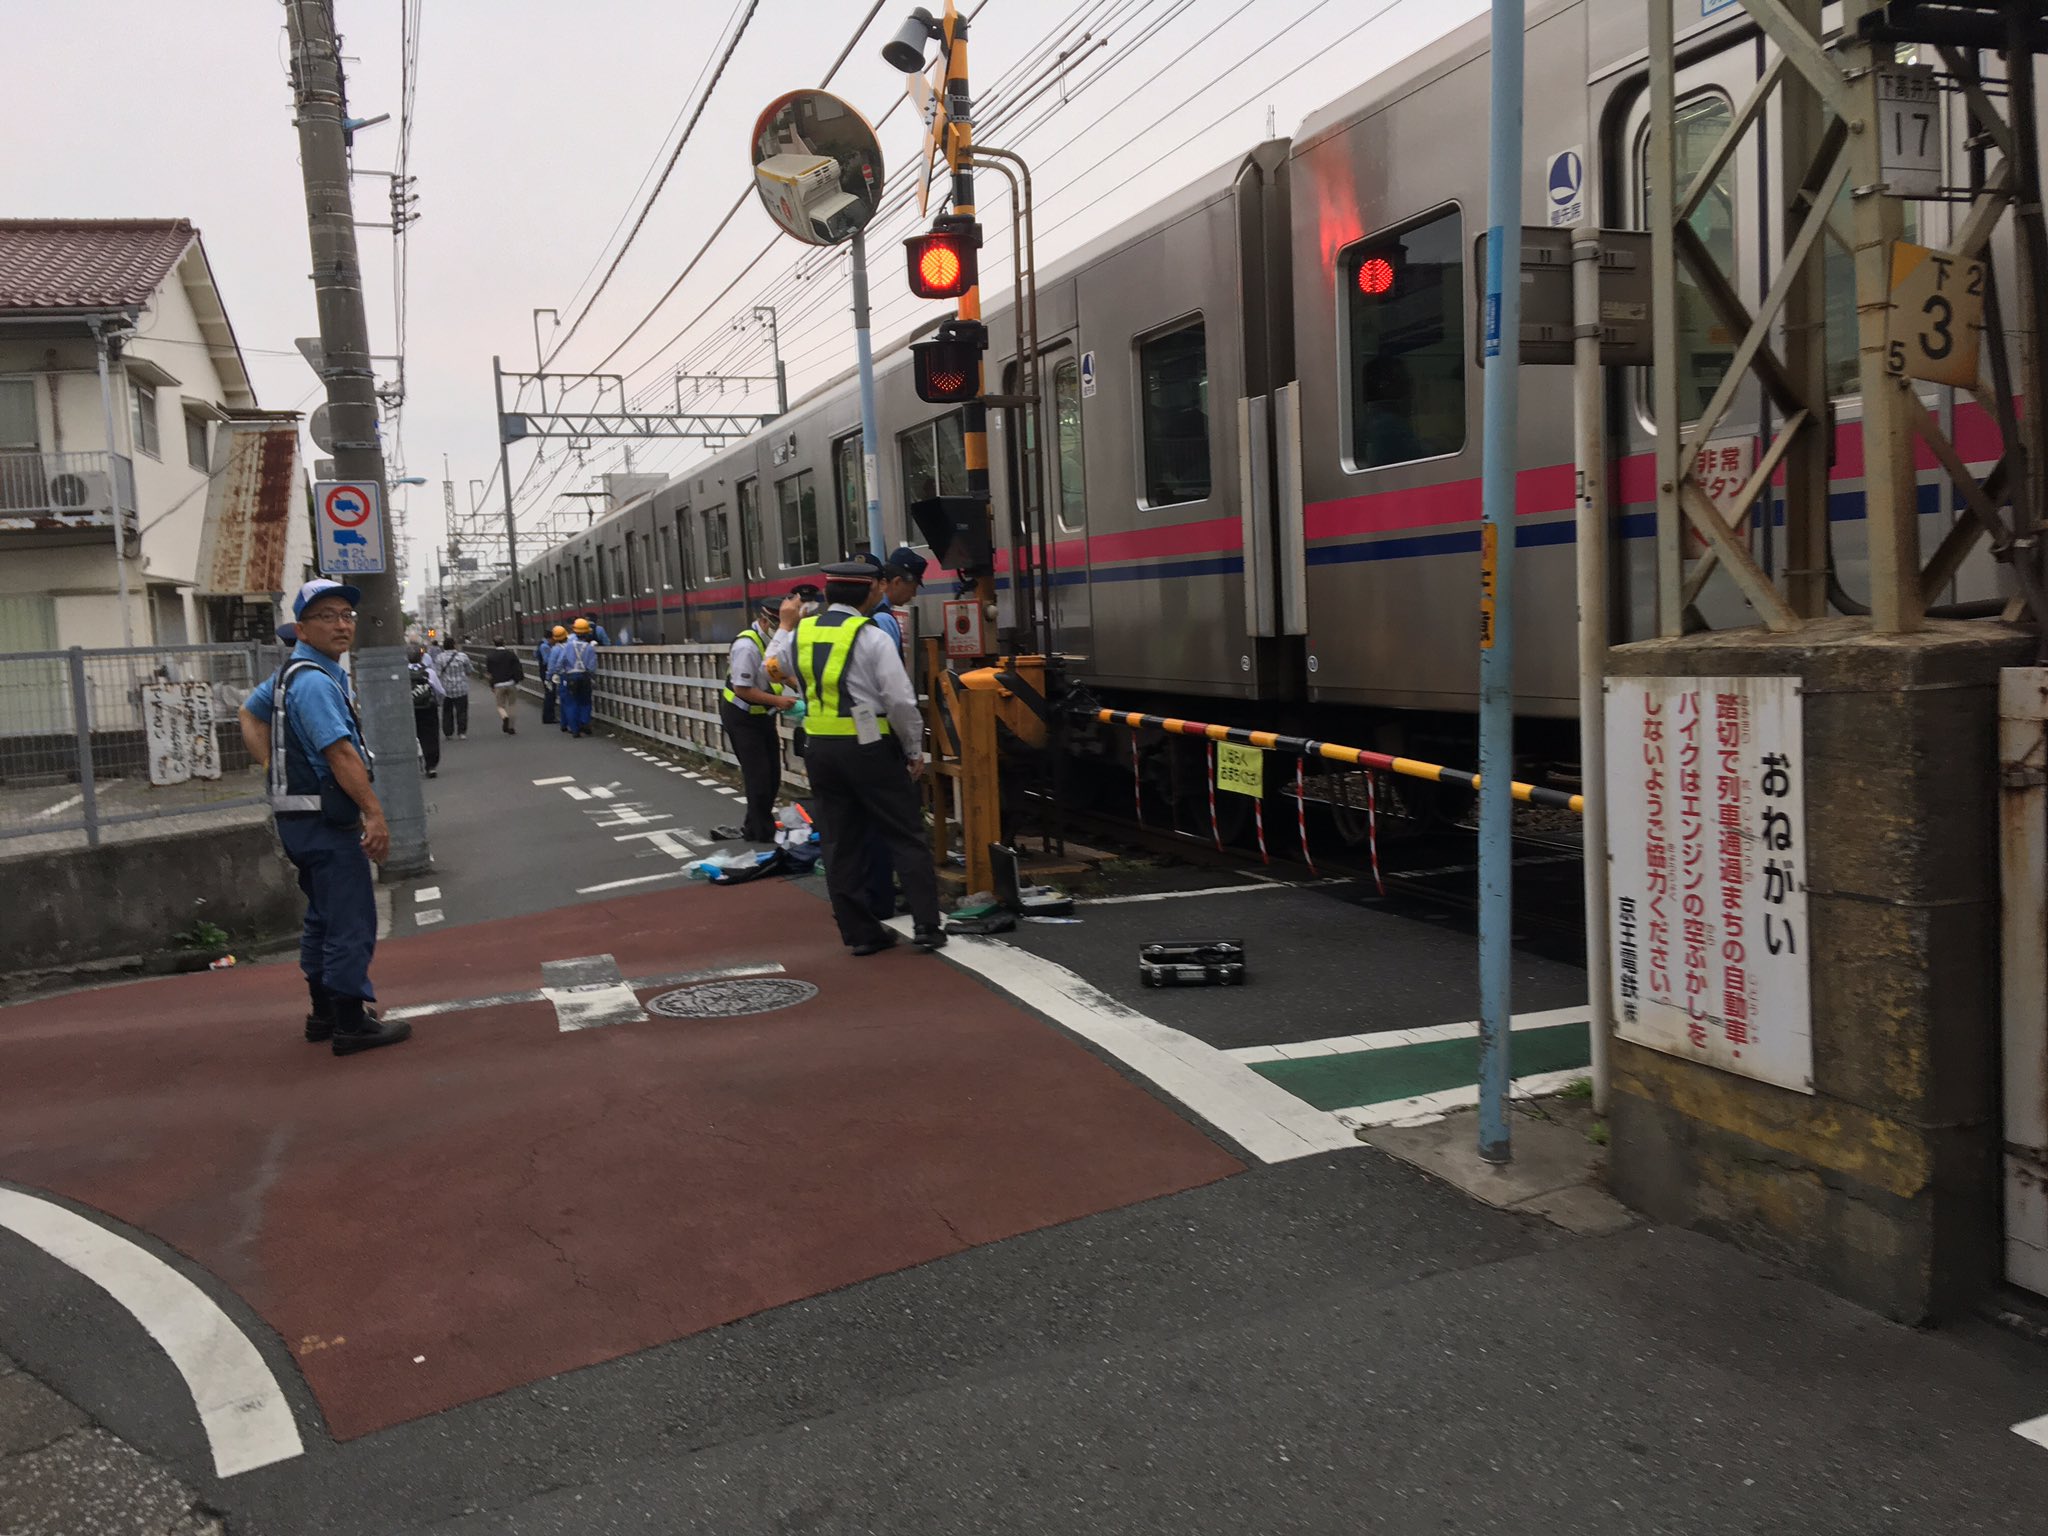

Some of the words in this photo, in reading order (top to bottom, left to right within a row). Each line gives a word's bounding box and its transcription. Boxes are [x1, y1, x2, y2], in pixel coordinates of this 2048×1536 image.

[1895, 112, 1930, 157] 17
[1966, 264, 1982, 296] 2
[1919, 295, 1953, 360] 3
[1888, 340, 1905, 372] 5
[1696, 447, 1739, 473] 非常
[1643, 692, 1671, 1005] しないようご協力ください。
[1678, 691, 1709, 1048] バイクはエンジンの空ぶかしを
[1761, 752, 1797, 955] おねがい
